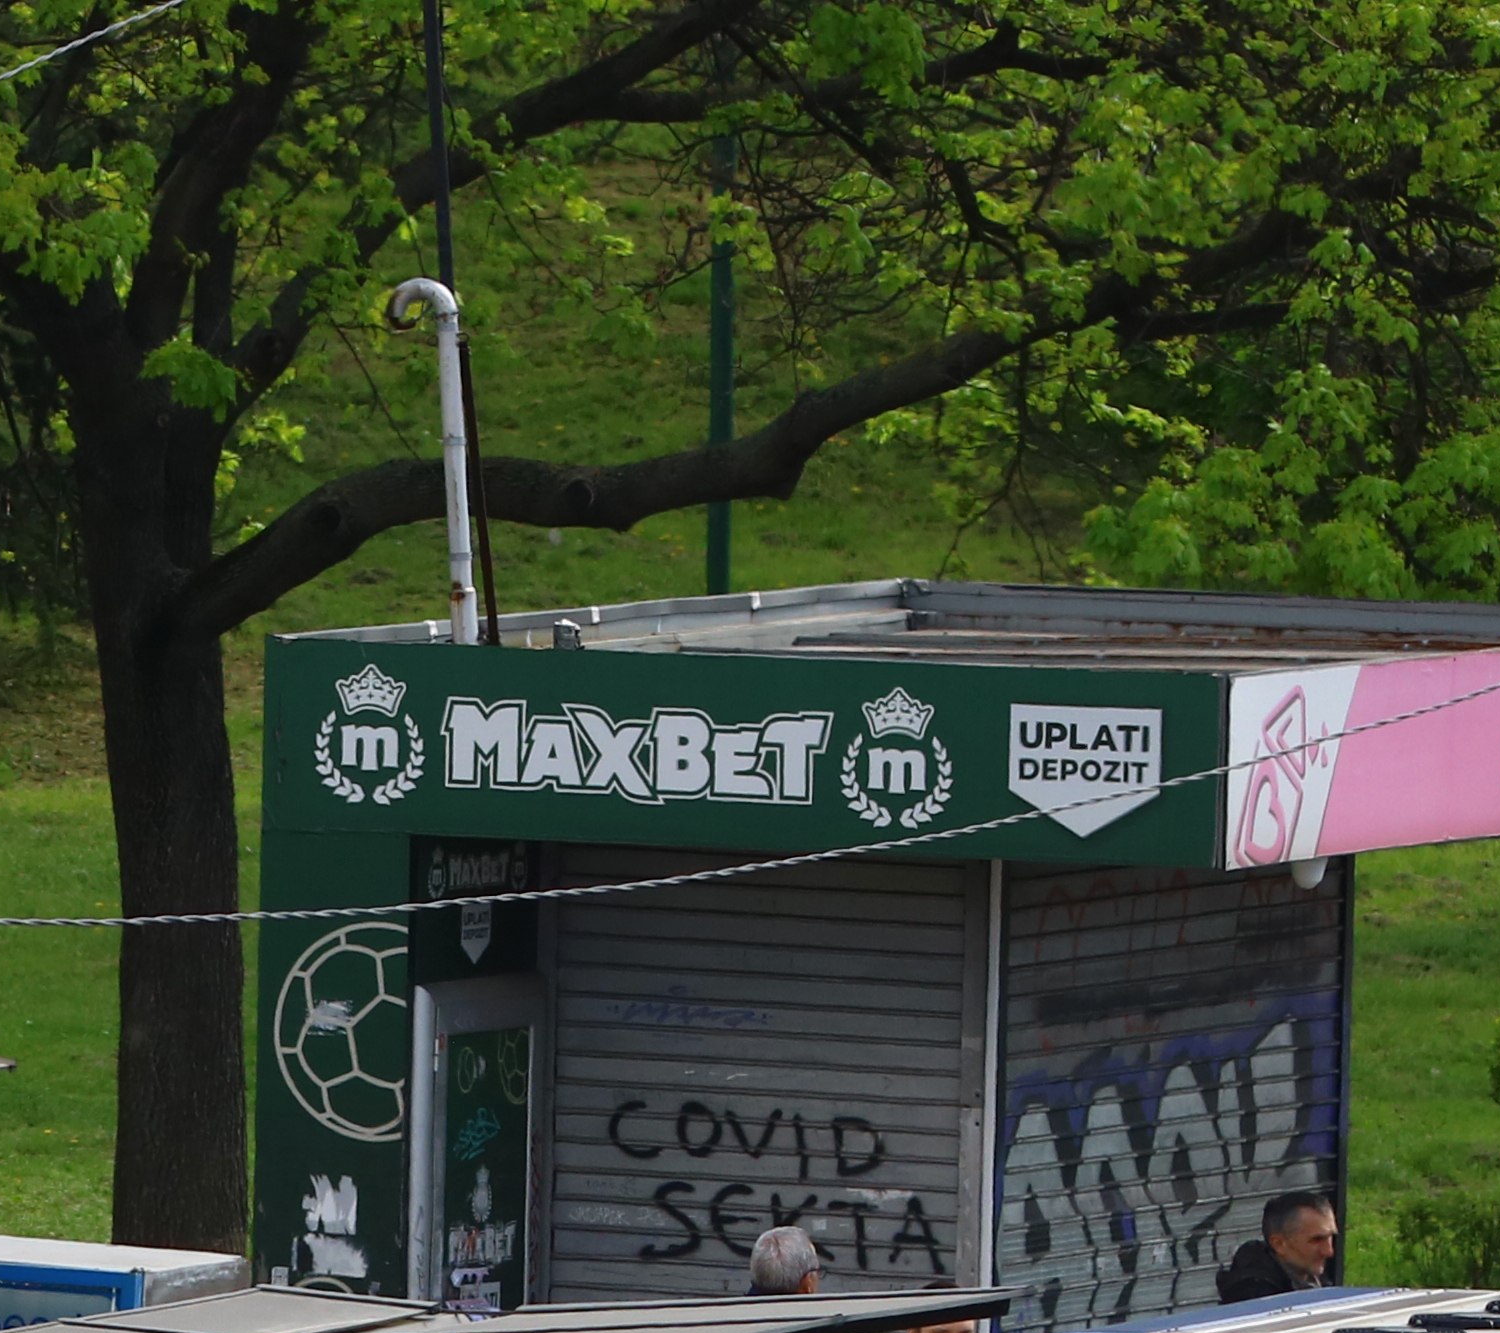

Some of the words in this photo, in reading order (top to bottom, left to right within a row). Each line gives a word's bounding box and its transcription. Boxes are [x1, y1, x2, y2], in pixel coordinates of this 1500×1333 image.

[1020, 721, 1150, 753] UPLATI
[1018, 758, 1149, 784] DEPOZIT
[609, 1101, 886, 1181] COVID
